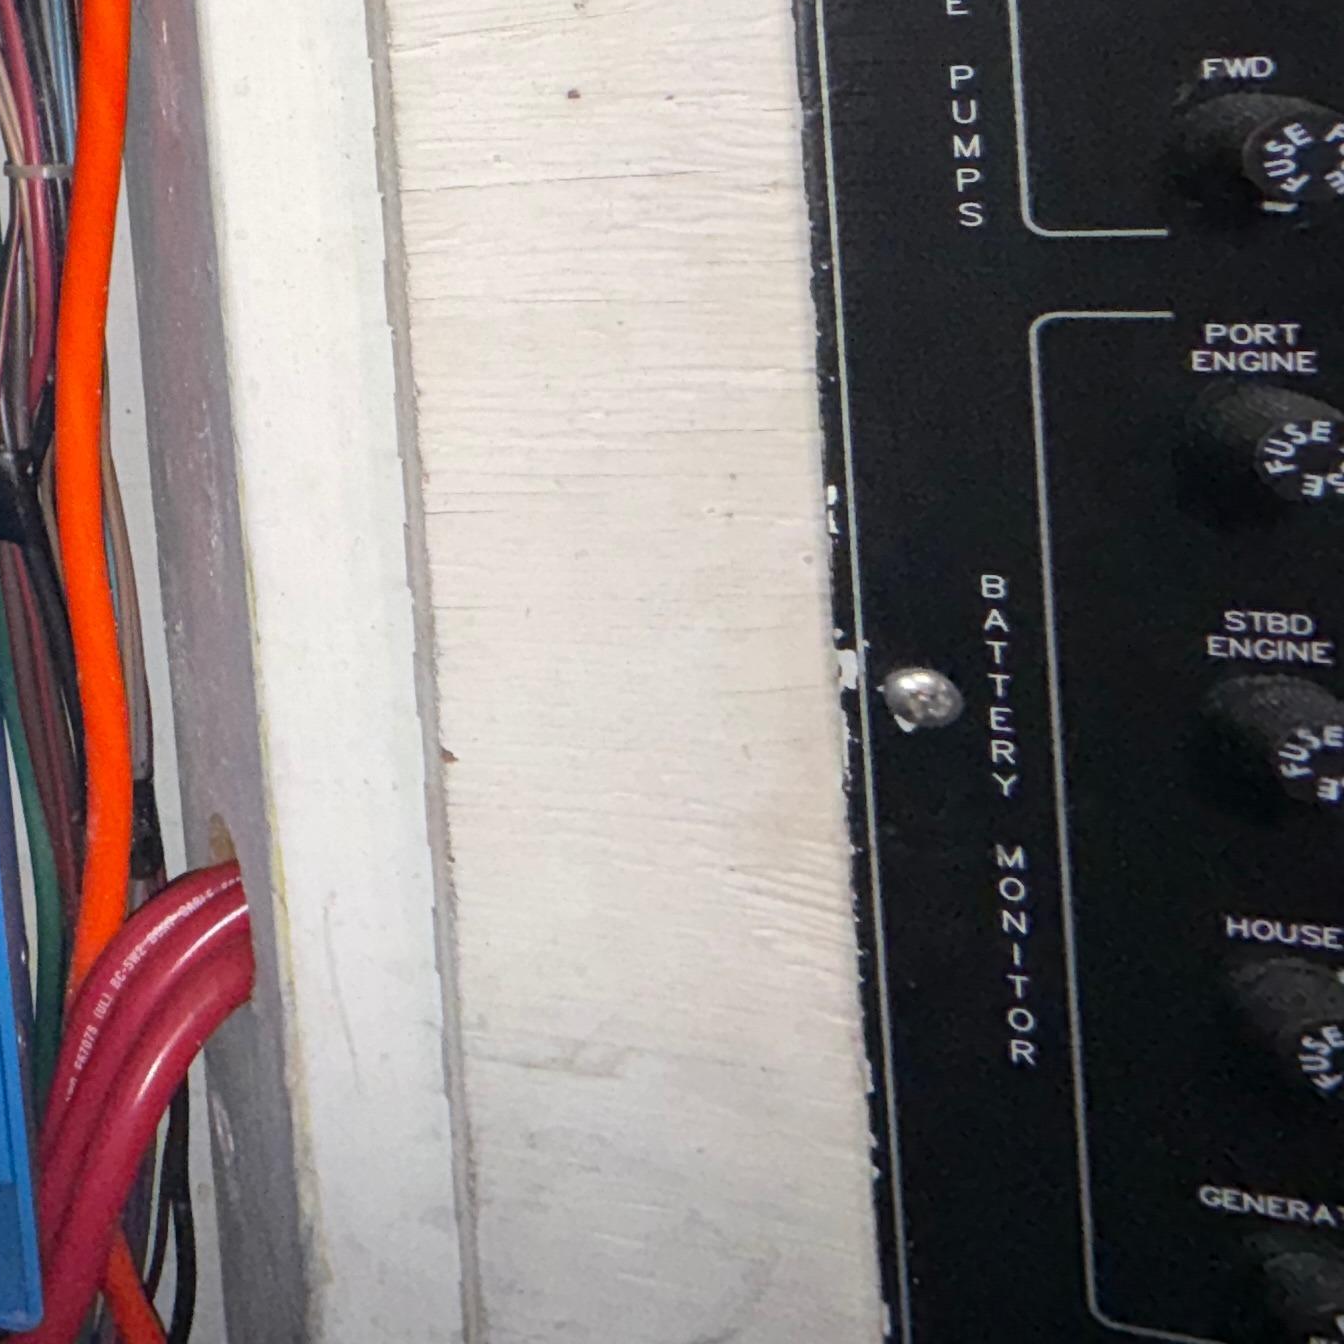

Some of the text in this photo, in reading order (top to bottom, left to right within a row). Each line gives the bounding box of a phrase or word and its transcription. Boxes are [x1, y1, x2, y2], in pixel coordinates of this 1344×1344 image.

[1201, 56, 1275, 80] FWD
[950, 64, 985, 228] PUMPS
[1205, 323, 1301, 346] PORT
[1191, 350, 1317, 373] ENGINE
[1223, 610, 1313, 636] STBD
[1206, 634, 1333, 665] ENGINE
[980, 573, 1036, 1067] BATTERY MONITOR
[1226, 914, 1343, 950] HOUSE
[1198, 1184, 1344, 1228] GENERA
